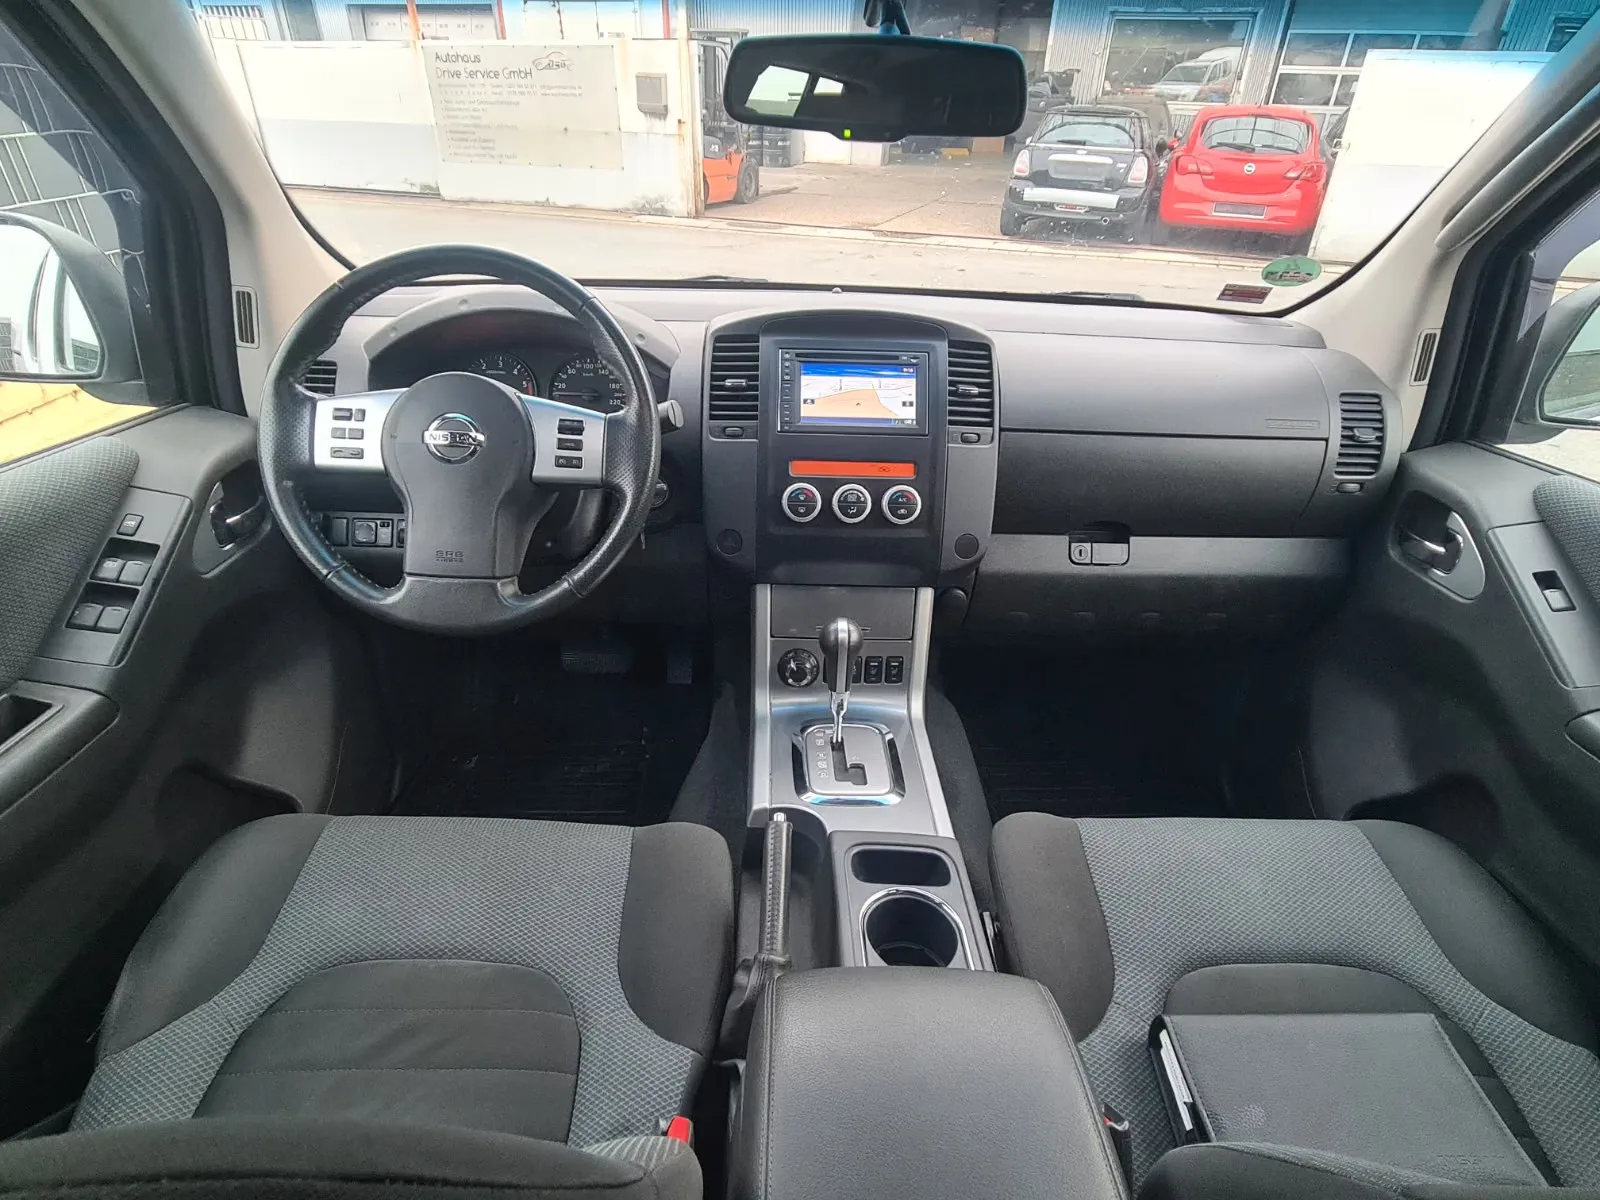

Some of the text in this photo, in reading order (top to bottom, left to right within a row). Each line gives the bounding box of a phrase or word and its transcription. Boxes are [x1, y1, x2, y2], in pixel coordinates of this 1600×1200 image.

[435, 51, 481, 63] Autohaus
[435, 66, 533, 79] Drive Service GmbH
